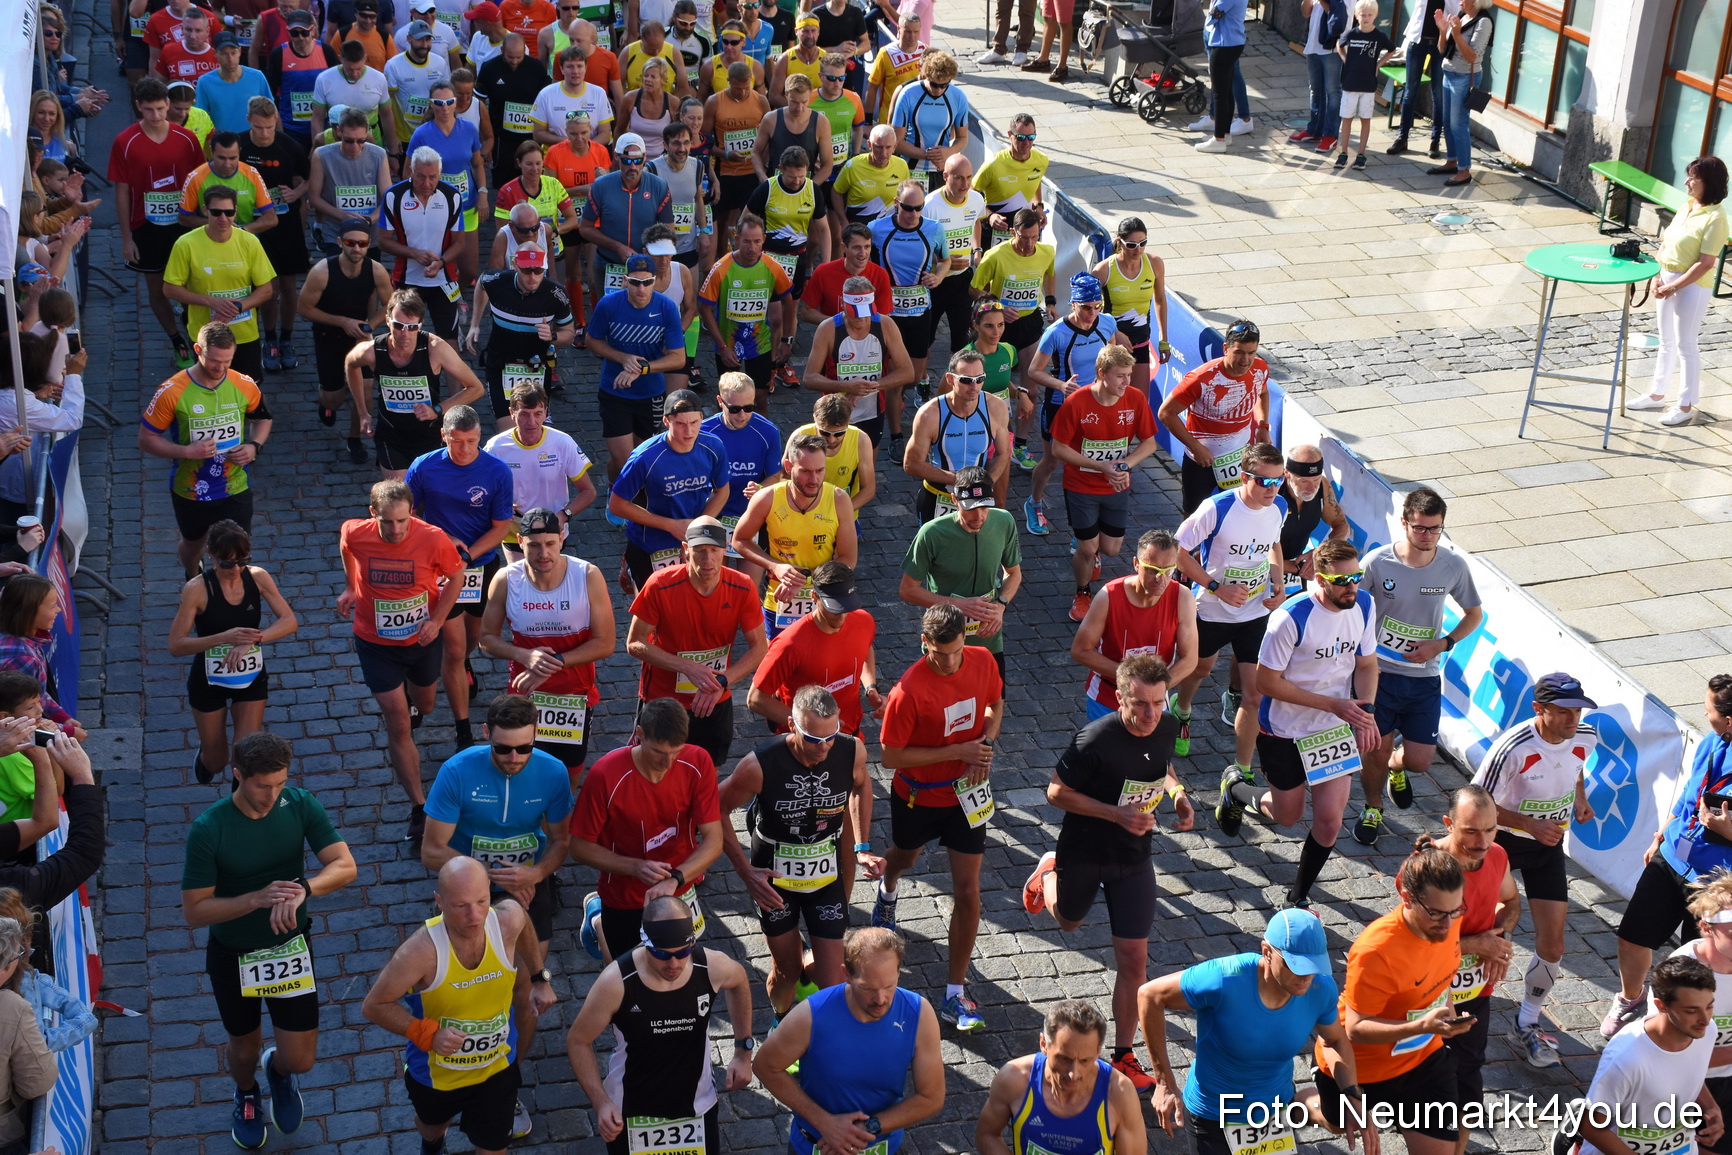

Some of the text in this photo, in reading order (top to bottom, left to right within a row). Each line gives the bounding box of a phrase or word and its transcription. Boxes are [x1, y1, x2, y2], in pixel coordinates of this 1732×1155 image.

[895, 66, 914, 76] MAX
[293, 92, 314, 101] BOC
[726, 131, 757, 141] BOCK
[728, 139, 755, 151] 1192
[575, 173, 588, 185] DH
[337, 185, 374, 197] BOCK
[148, 192, 181, 203] BOCK
[341, 197, 372, 209] 2034
[150, 203, 181, 215] 2562
[948, 238, 971, 250] 395
[1005, 279, 1041, 290] BOCK
[211, 288, 249, 300] BOCK
[729, 289, 768, 299] BOCK
[893, 286, 927, 297] BOCK
[1006, 289, 1037, 301] 2006
[732, 300, 764, 312] 1279
[893, 296, 925, 308] 2638
[730, 312, 764, 320] FRIEDEMANN
[842, 363, 880, 374] BOCK
[383, 377, 427, 387] BOCK
[387, 388, 425, 401] 2005
[193, 413, 235, 429] BOCK
[1084, 440, 1127, 450] BOCK
[1086, 449, 1123, 462] 2247
[1216, 448, 1243, 467] BOC
[665, 475, 707, 492] SYSCAD
[1222, 479, 1243, 487] FERDI
[813, 534, 826, 544] MTP
[654, 549, 681, 561] BOC
[1225, 560, 1270, 578] BOCK
[371, 572, 412, 584] 0774600
[377, 595, 425, 612] BOCK
[522, 601, 555, 612] speck
[783, 600, 815, 615] 213
[383, 608, 424, 628] 2042
[383, 627, 420, 638] CHRISTI
[526, 625, 572, 633] INGENIEURE
[1386, 617, 1434, 639] BOCK
[684, 647, 728, 663] BOCK
[534, 694, 582, 709] BOCK
[538, 709, 579, 727] 1084
[537, 728, 573, 738] MARKUS
[1302, 726, 1348, 750] BOCK
[1307, 741, 1352, 768] 2529
[1324, 763, 1345, 776] MAX
[775, 791, 847, 812] PIRATE
[966, 786, 992, 809] 130
[1526, 792, 1573, 812] BOCK
[781, 811, 807, 820] uvex
[479, 837, 531, 851] BOCK
[777, 842, 835, 858] BOCK
[782, 858, 829, 876] 1370
[245, 937, 309, 962] BOCK
[1461, 955, 1481, 971] OCK
[249, 957, 304, 983] 1323
[461, 970, 504, 990] DIADORA
[1451, 968, 1483, 988] 091
[255, 982, 301, 997] THOMAS
[451, 1012, 506, 1035] BOCK
[664, 1018, 696, 1026] Marathon
[653, 1025, 694, 1035] Regensburg
[461, 1033, 502, 1054] 063
[443, 1049, 499, 1065] CHRISTIAN
[638, 1125, 696, 1148] 1232
